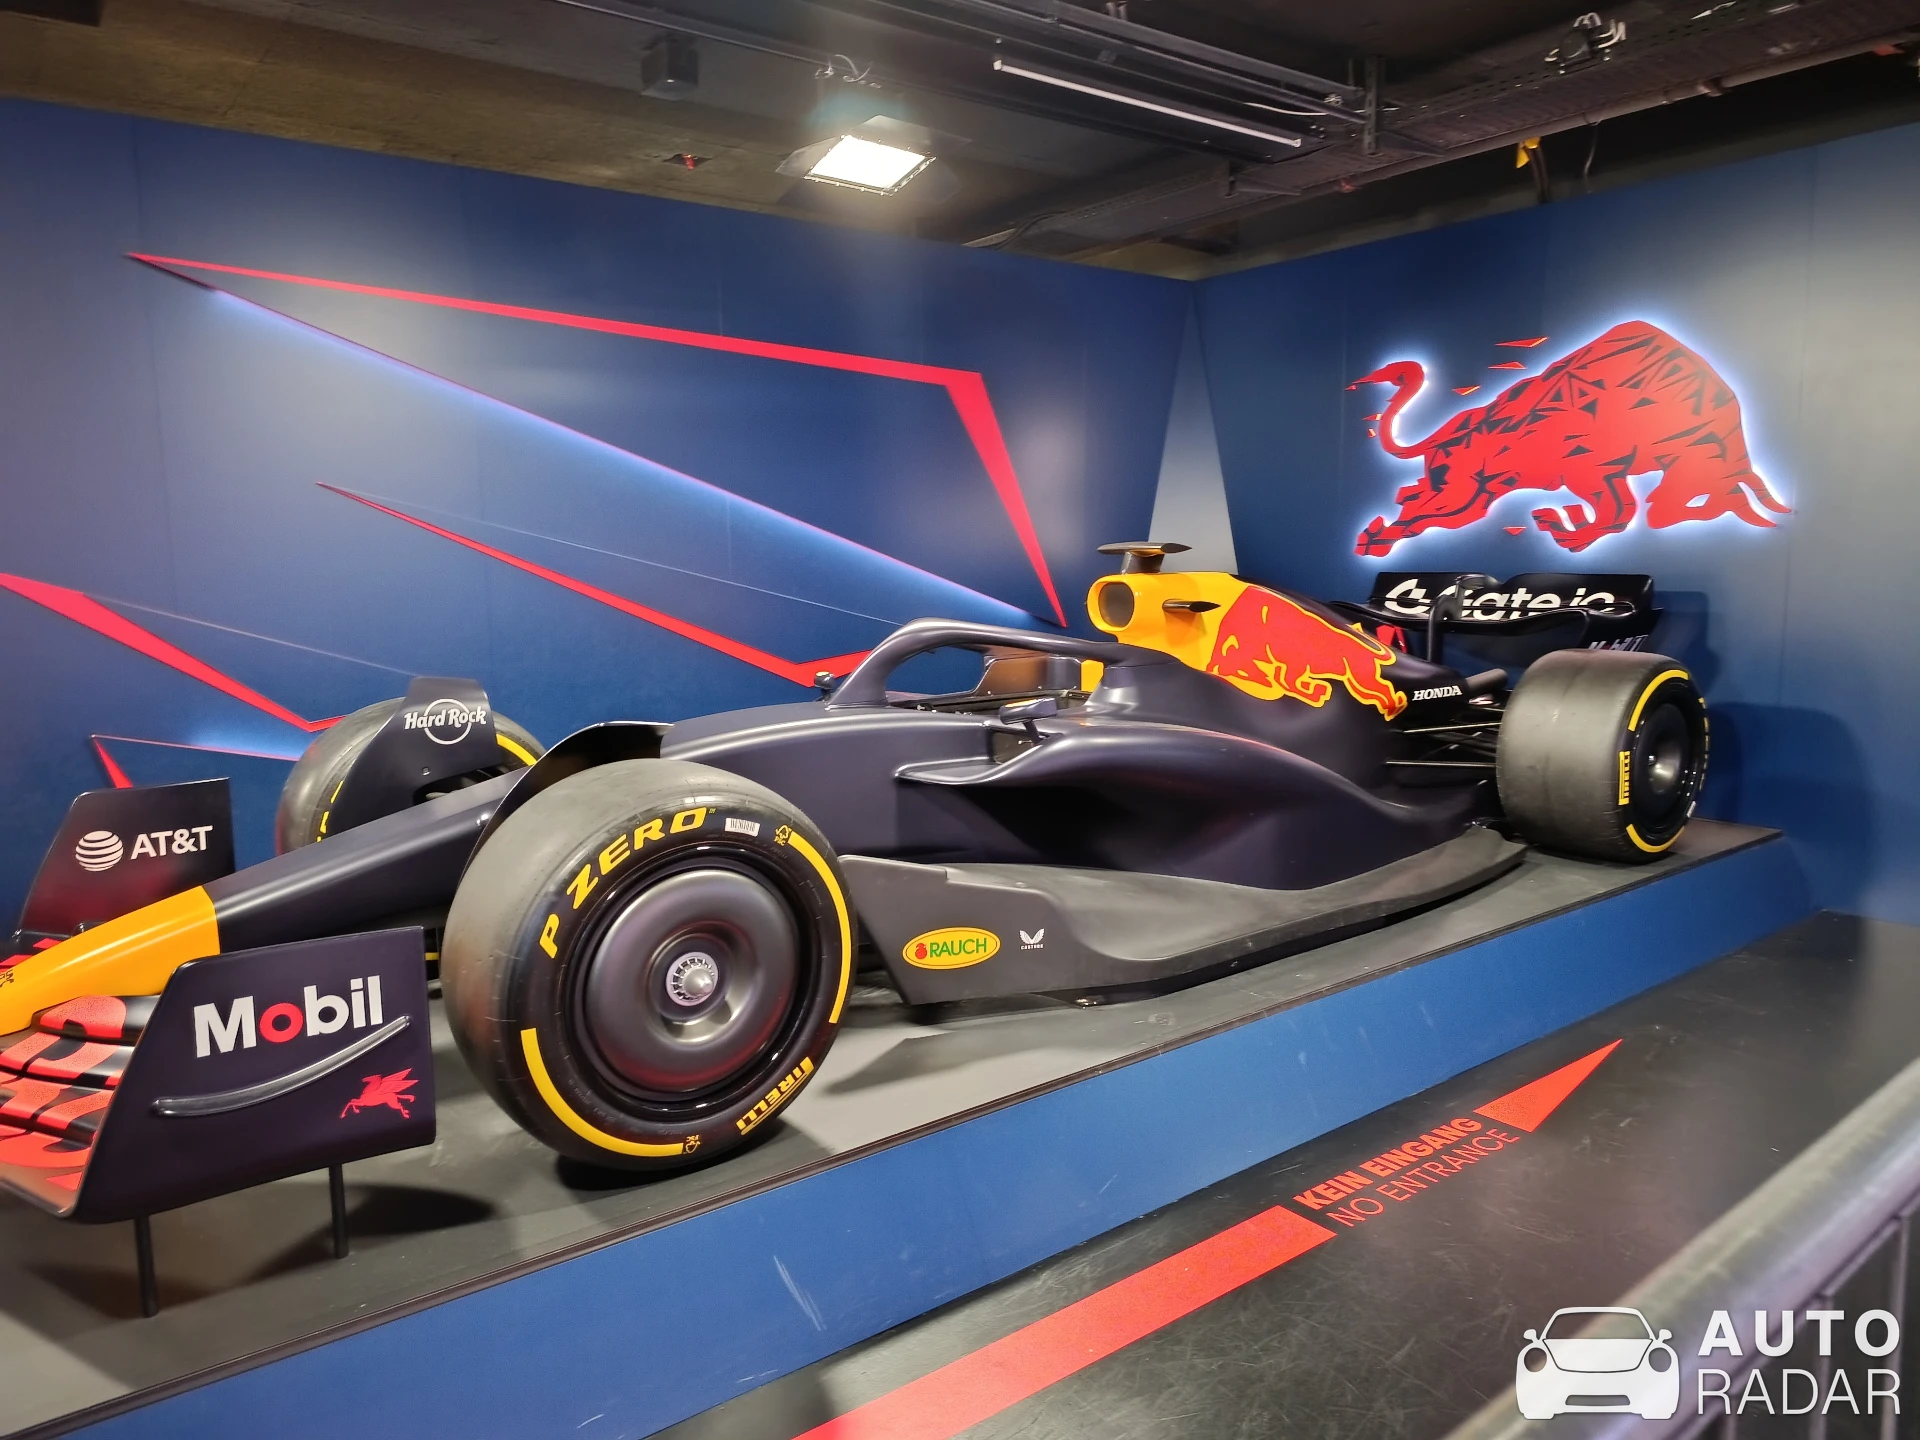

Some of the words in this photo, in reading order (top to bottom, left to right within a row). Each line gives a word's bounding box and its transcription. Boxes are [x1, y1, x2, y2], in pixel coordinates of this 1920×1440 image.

[404, 709, 447, 730] Hard
[447, 706, 487, 728] Rock
[1412, 686, 1463, 701] HONDA
[1618, 750, 1631, 806] PIRELLI
[131, 825, 214, 860] AT&T
[539, 913, 560, 959] P
[566, 807, 707, 910] ZERO
[929, 938, 987, 958] RAUCH
[193, 975, 384, 1058] Mobil
[736, 1056, 815, 1136] PIRELLI
[1293, 1170, 1374, 1211] KEIN
[1359, 1118, 1482, 1177] EINGANG
[1326, 1197, 1384, 1227] NO
[1375, 1128, 1521, 1202] ENTRANCE
